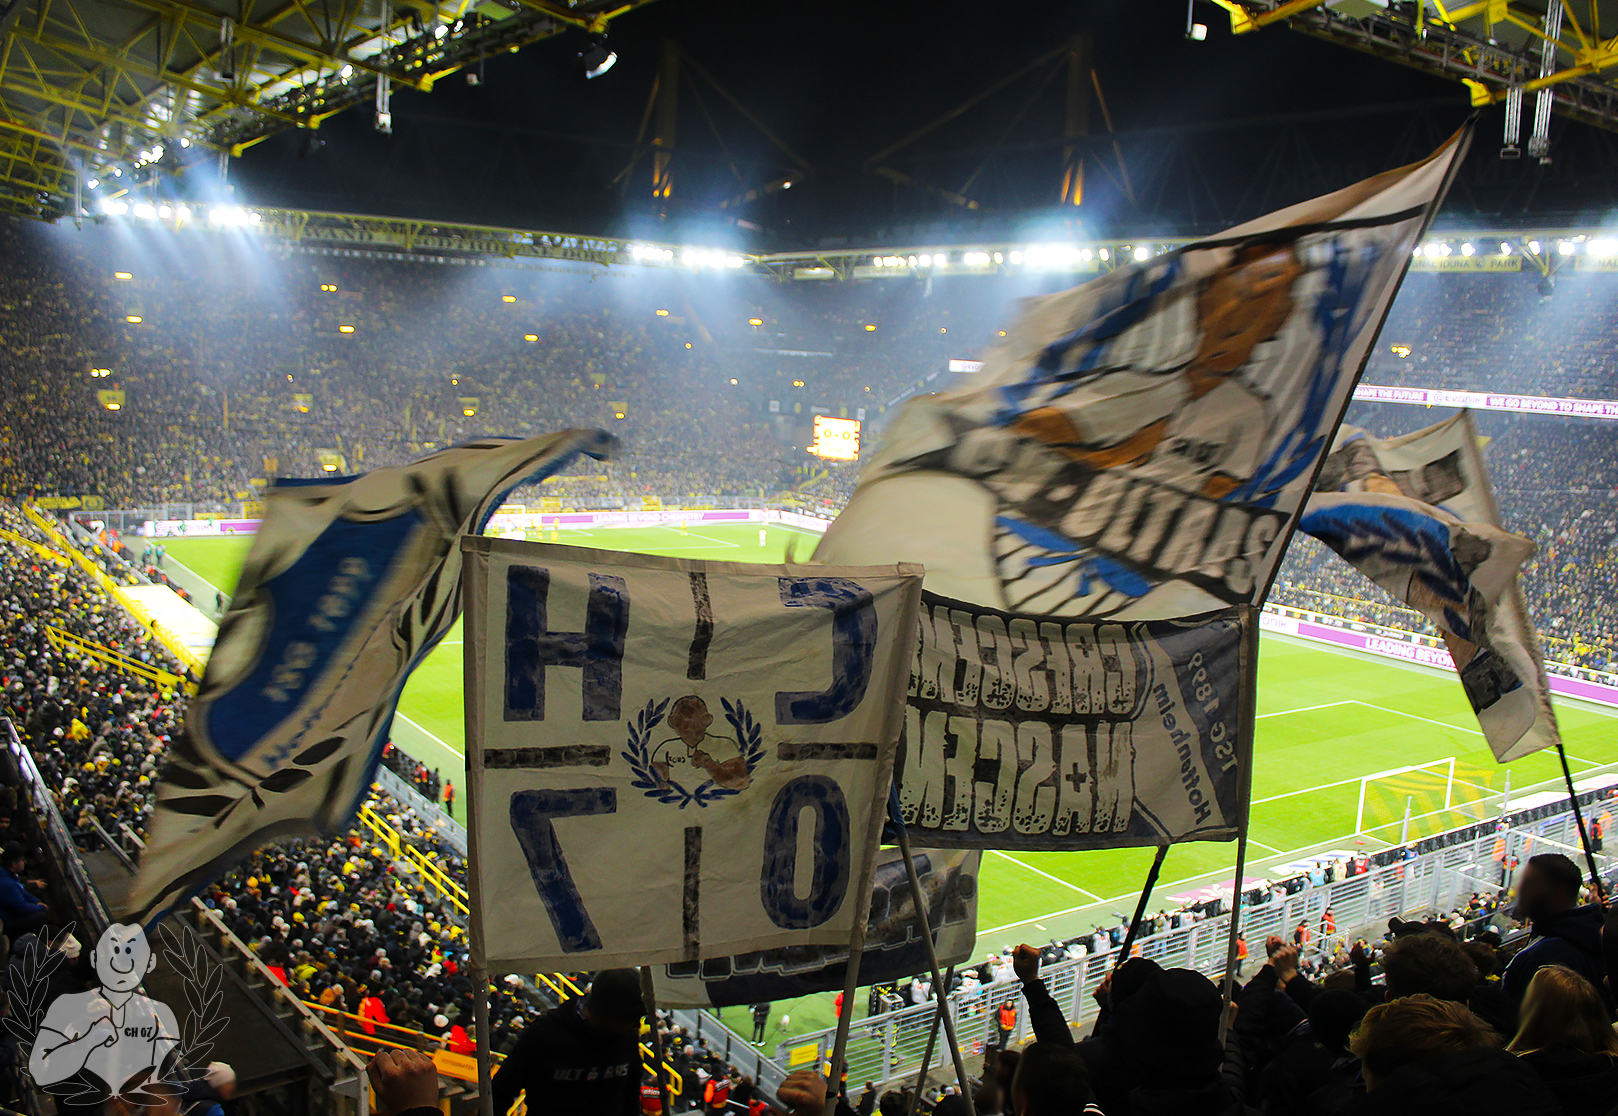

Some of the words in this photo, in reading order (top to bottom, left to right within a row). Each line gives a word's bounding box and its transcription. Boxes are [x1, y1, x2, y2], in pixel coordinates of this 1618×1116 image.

[1491, 258, 1518, 268] PARK
[1395, 389, 1424, 400] FUTURE
[1489, 396, 1506, 407] WE
[1506, 398, 1520, 408] GO
[1520, 398, 1559, 411] BEYOND
[1559, 402, 1573, 411] TO
[1365, 637, 1415, 658] LEADING
